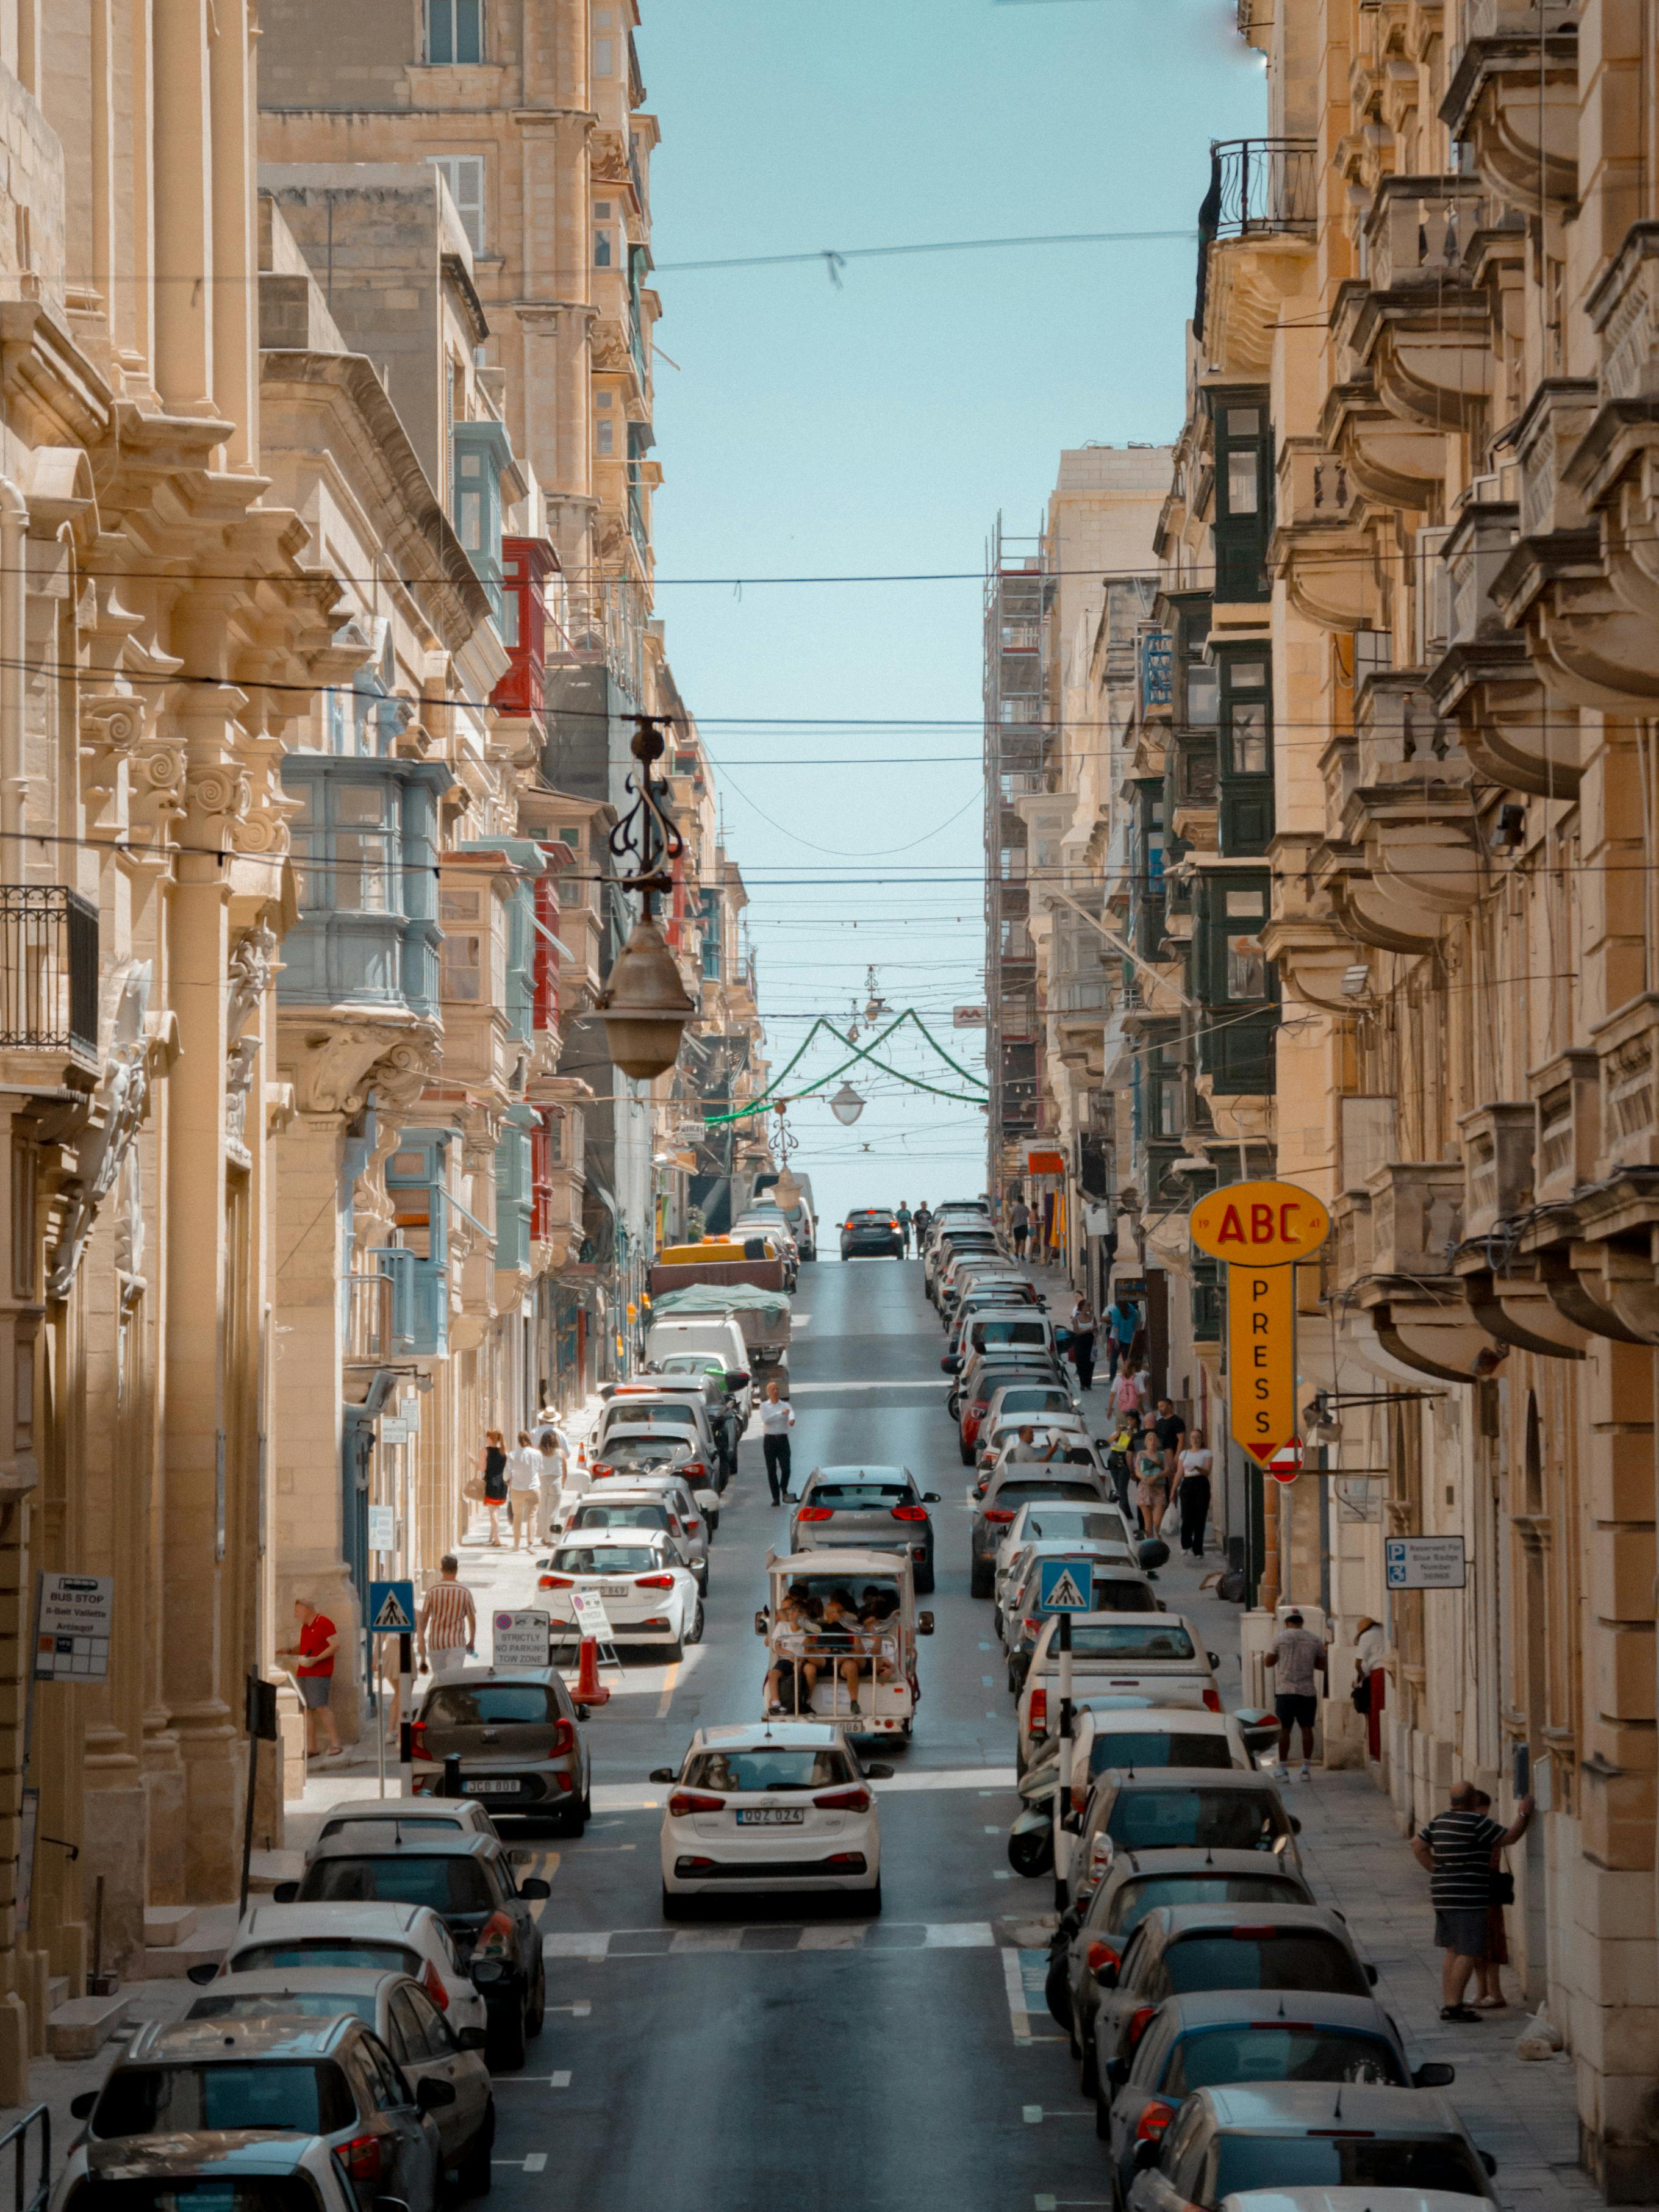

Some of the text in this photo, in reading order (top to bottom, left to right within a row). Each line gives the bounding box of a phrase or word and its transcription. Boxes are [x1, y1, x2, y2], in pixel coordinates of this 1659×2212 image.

[1199, 1219, 1209, 1229] 19
[1217, 1203, 1300, 1244] ABC
[1310, 1218, 1320, 1228] 41
[1253, 1280, 1270, 1434] PRESS
[1391, 1545, 1403, 1561] P
[51, 1592, 104, 1603] BUS STOP
[74, 1609, 106, 1617] Valletta
[776, 1809, 799, 1820] 024
